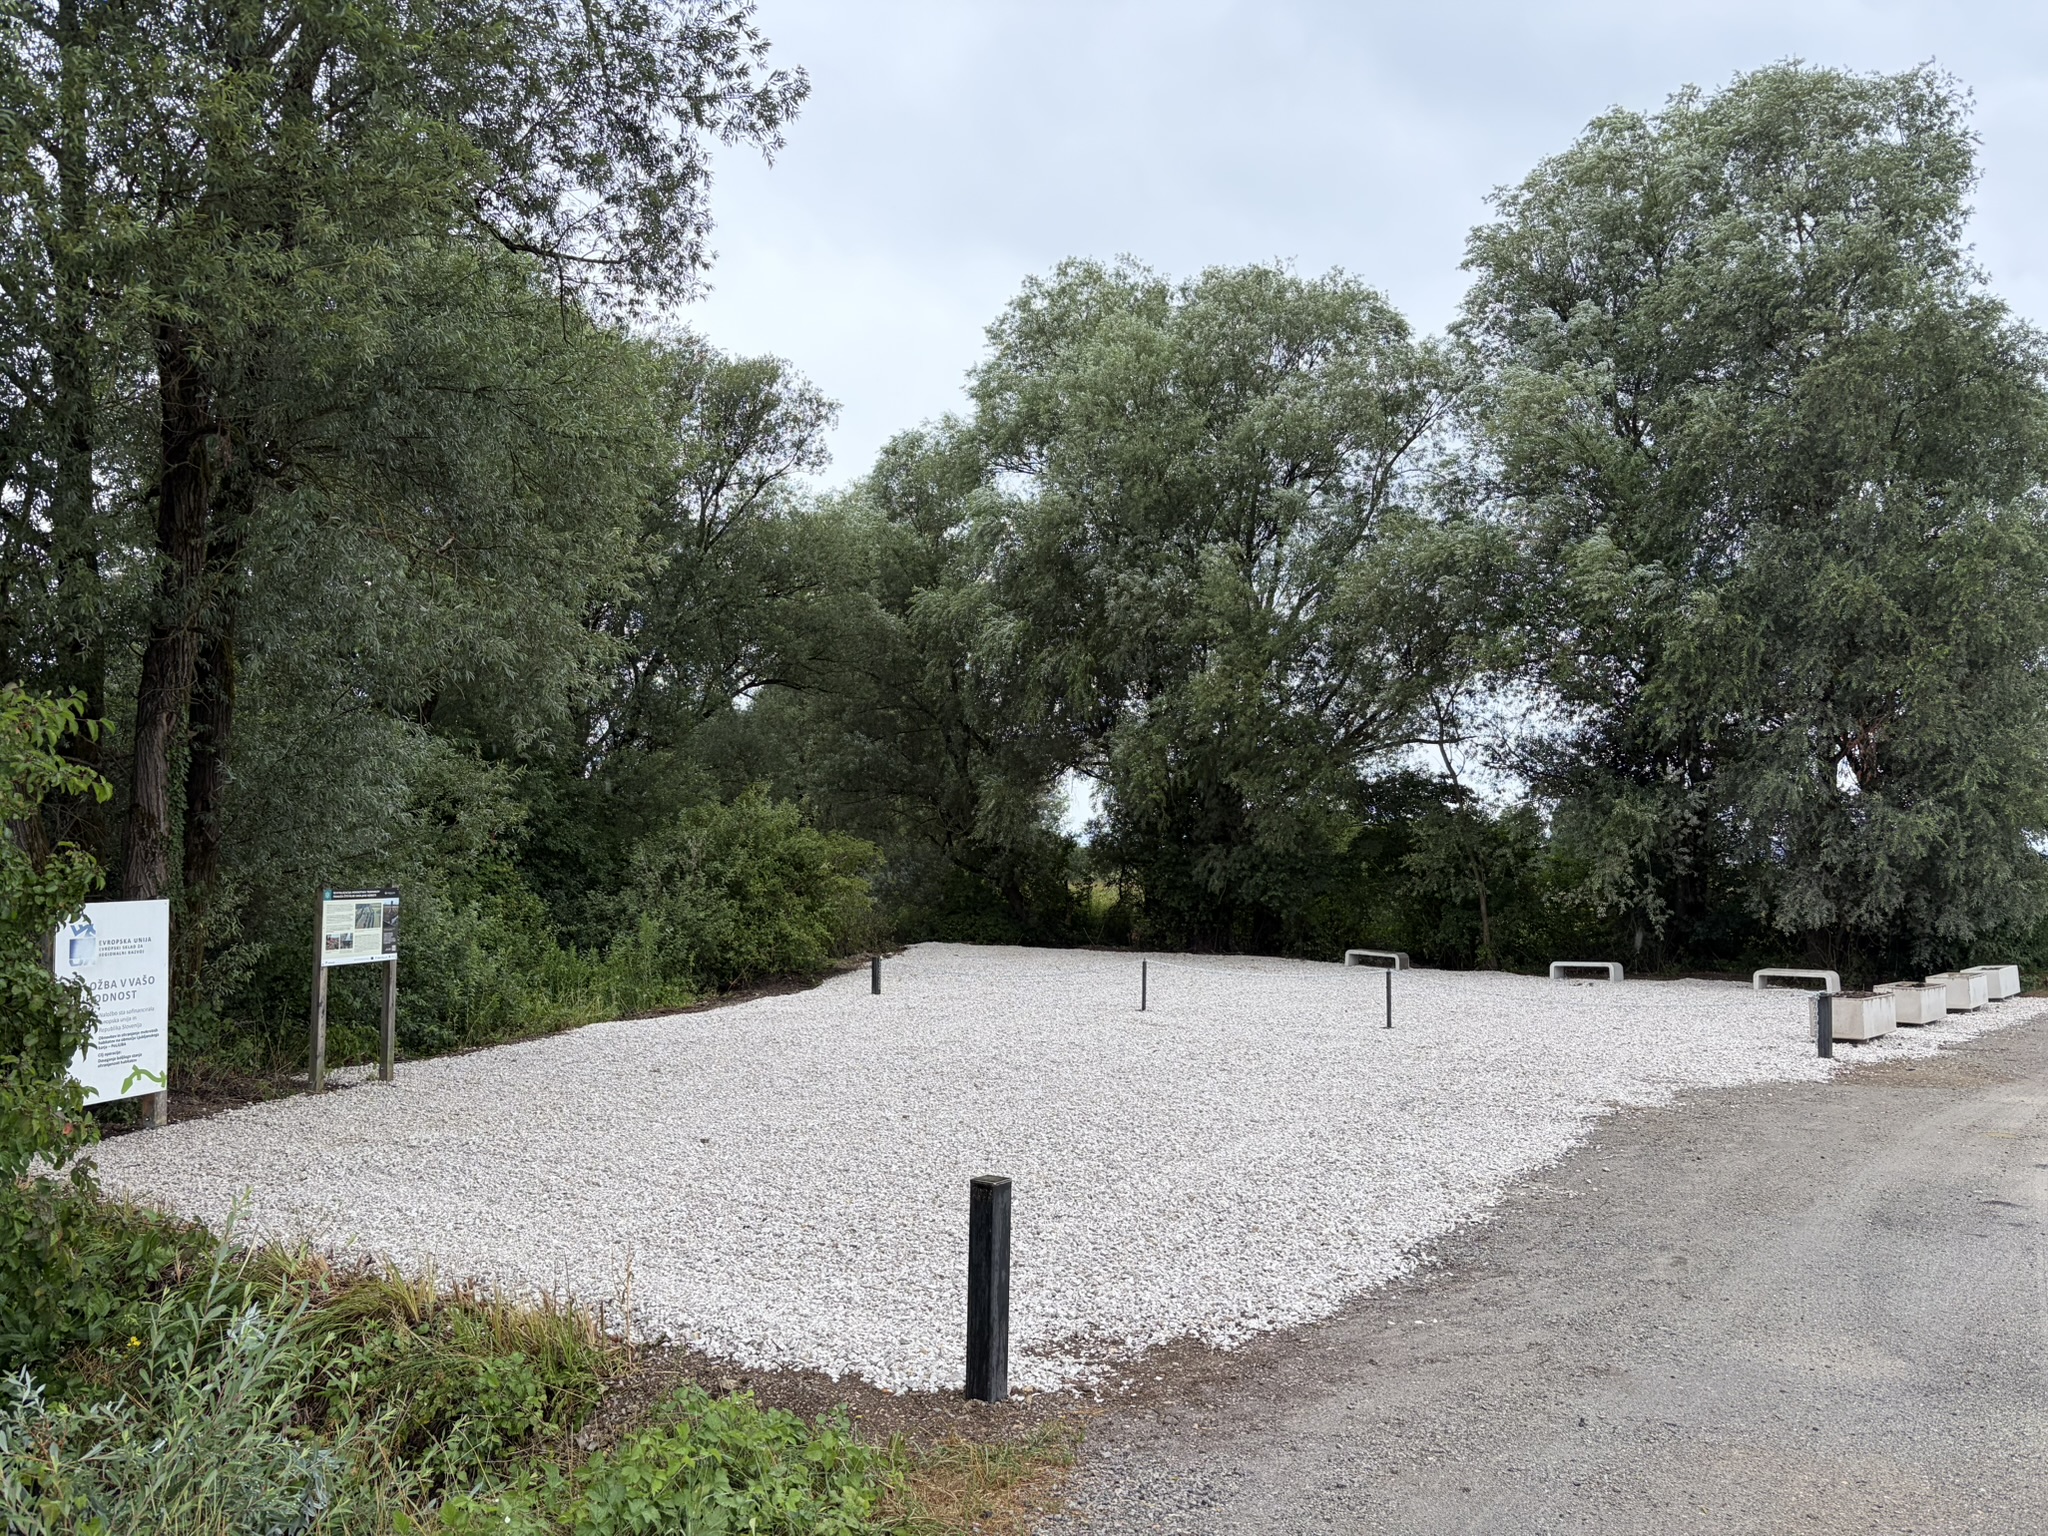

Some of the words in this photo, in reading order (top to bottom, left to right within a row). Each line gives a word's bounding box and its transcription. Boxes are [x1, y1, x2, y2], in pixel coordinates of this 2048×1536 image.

[99, 938, 131, 946] EVROPSKA
[133, 936, 152, 944] UNIJA
[90, 978, 117, 991] OŽBA
[120, 978, 127, 988] V
[129, 974, 155, 987] VAŠO
[95, 990, 137, 1003] ODNOST
